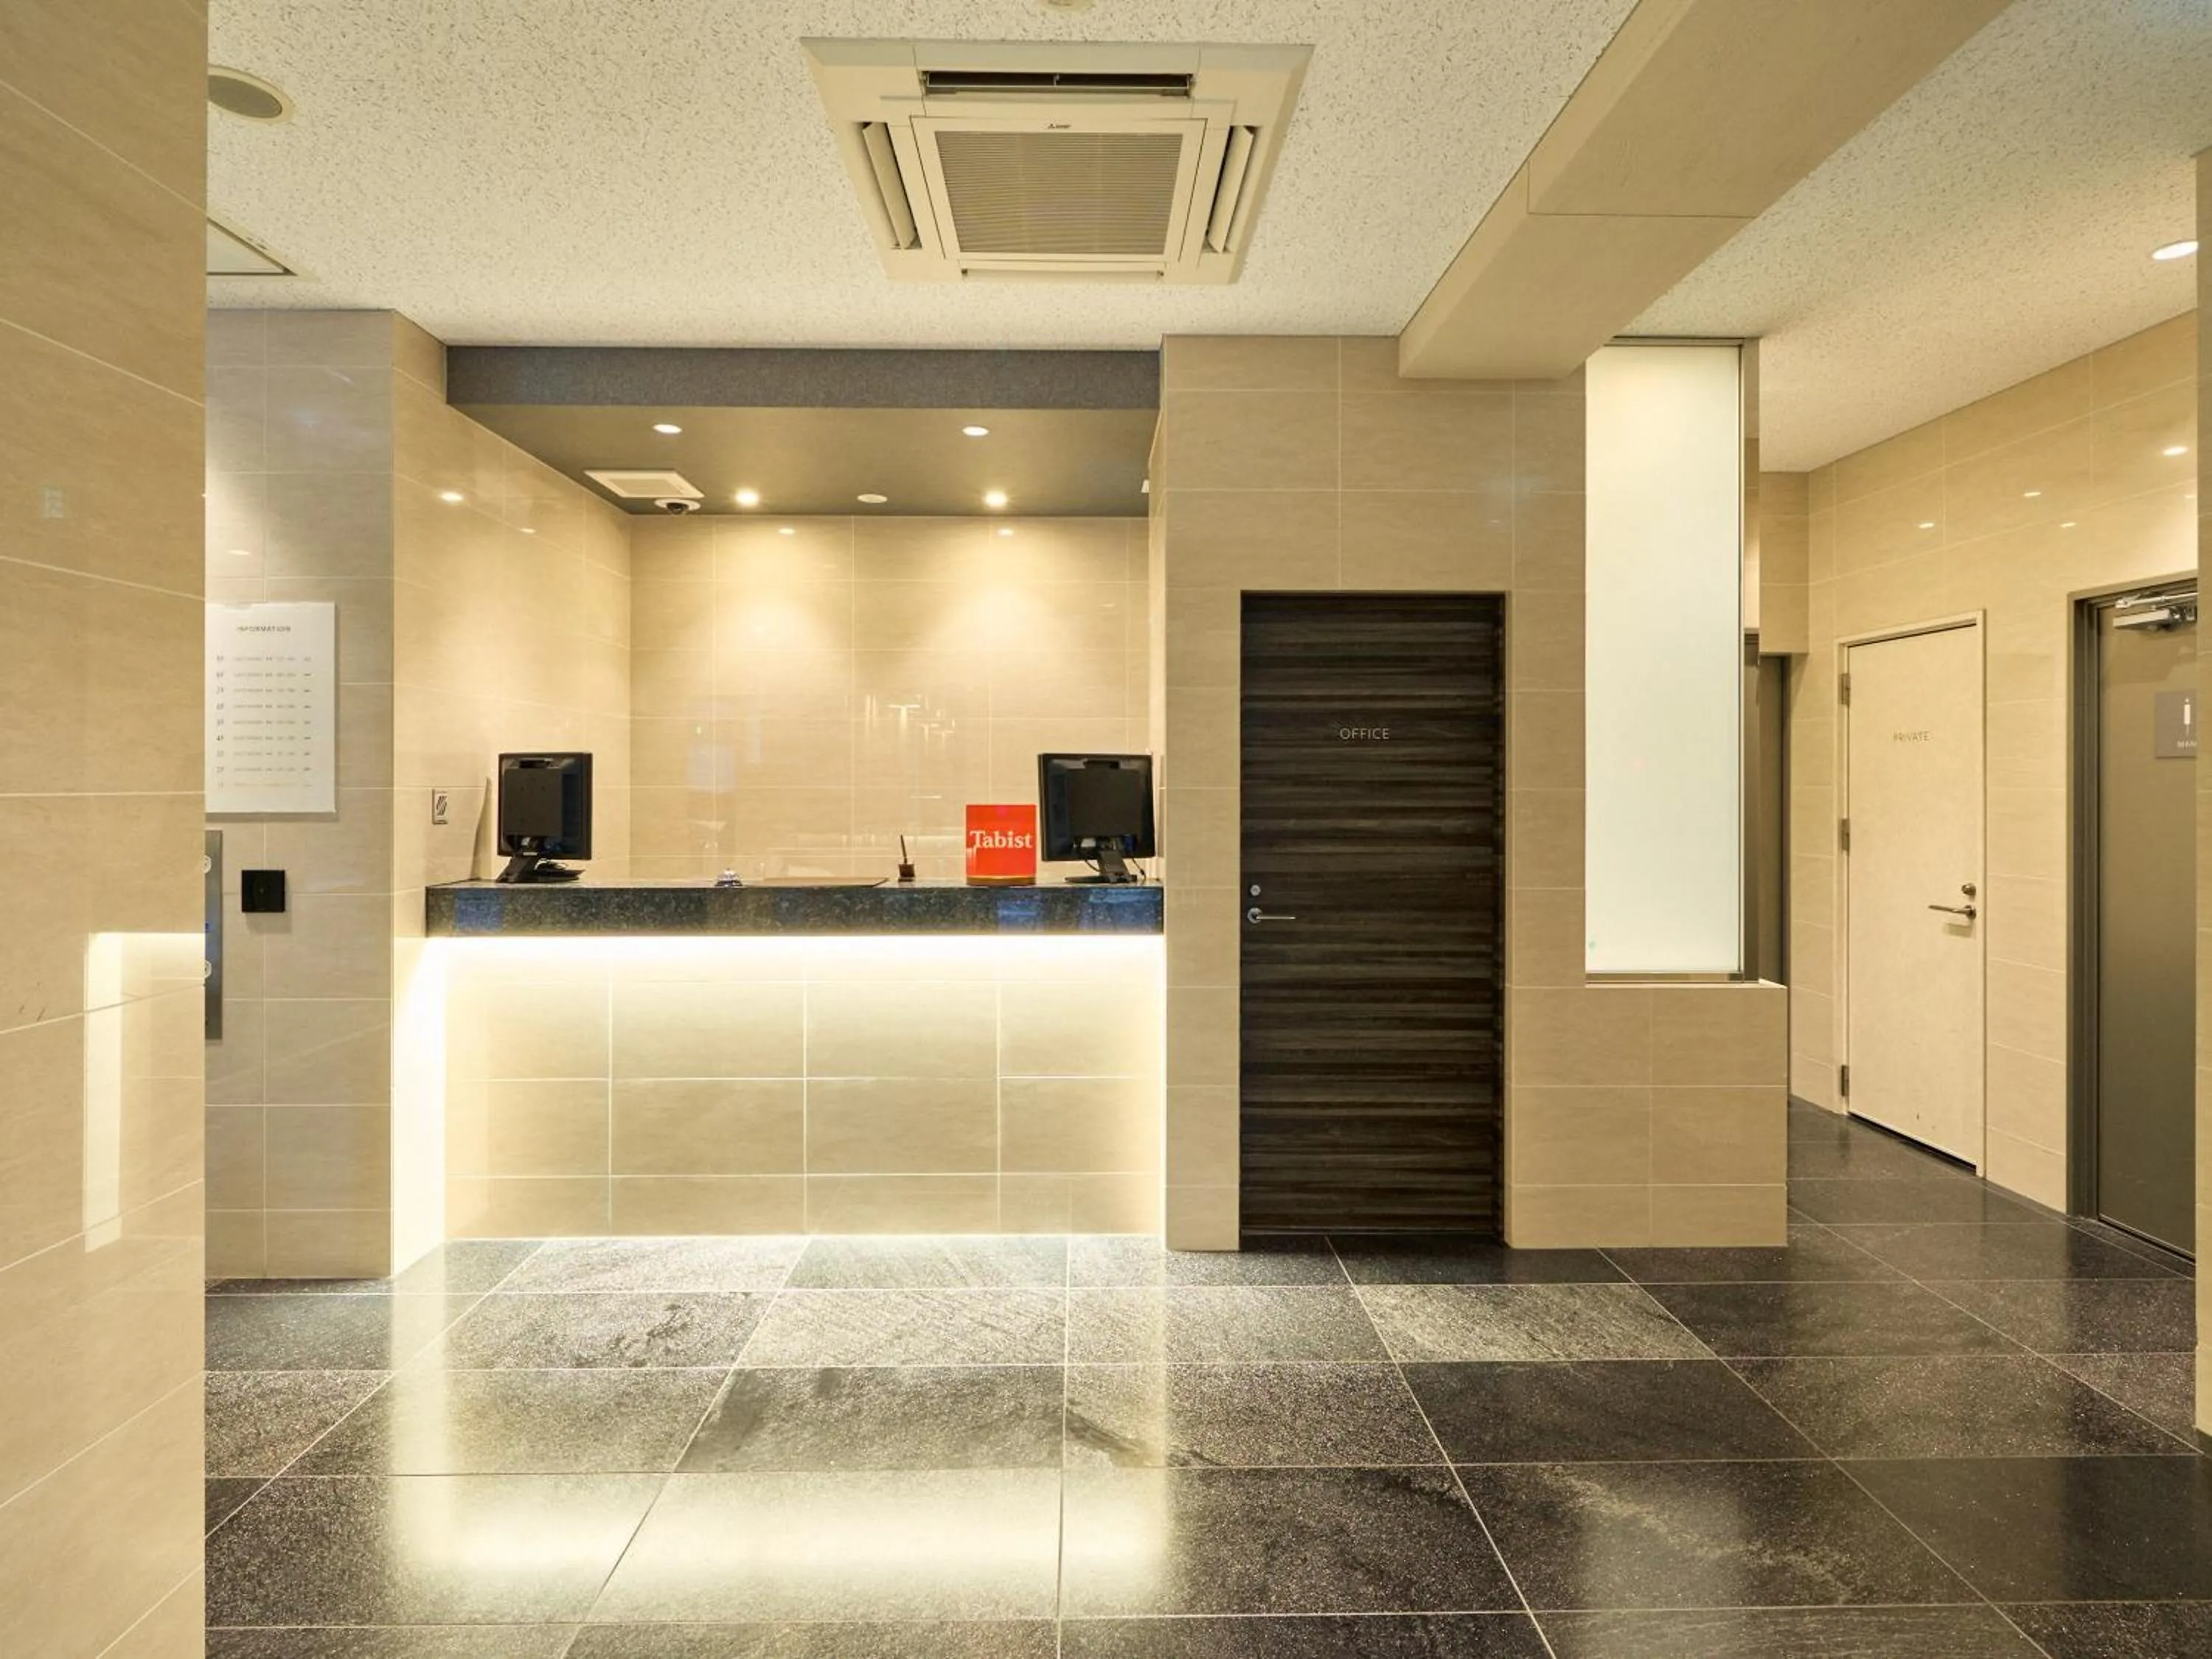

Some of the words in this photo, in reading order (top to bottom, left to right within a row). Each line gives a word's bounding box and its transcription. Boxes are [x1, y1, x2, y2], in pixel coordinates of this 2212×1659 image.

[1339, 727, 1390, 740] OFFICE
[1893, 730, 1930, 742] PRIVATE
[969, 829, 1033, 849] Tabist
